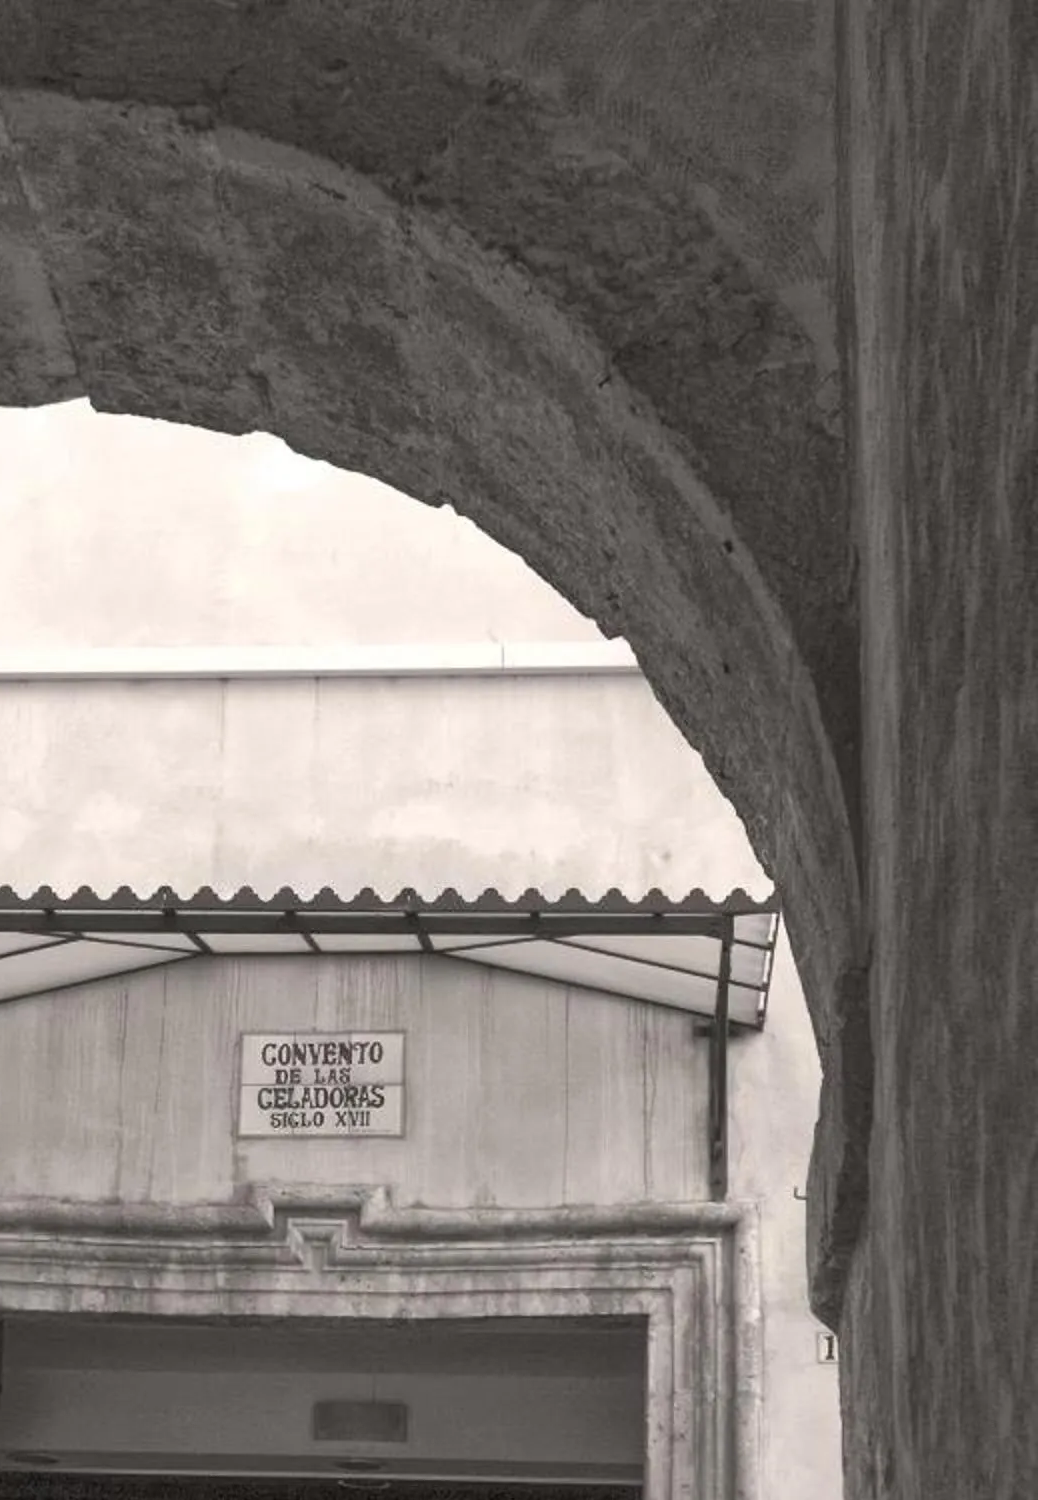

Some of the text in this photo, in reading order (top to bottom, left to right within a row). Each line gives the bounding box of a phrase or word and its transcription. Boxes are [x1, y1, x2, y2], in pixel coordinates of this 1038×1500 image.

[261, 1041, 384, 1066] CONVENTO
[274, 1067, 351, 1085] DE LAS
[257, 1084, 385, 1110] CELADORAS
[270, 1111, 371, 1129] SIGLO XVII
